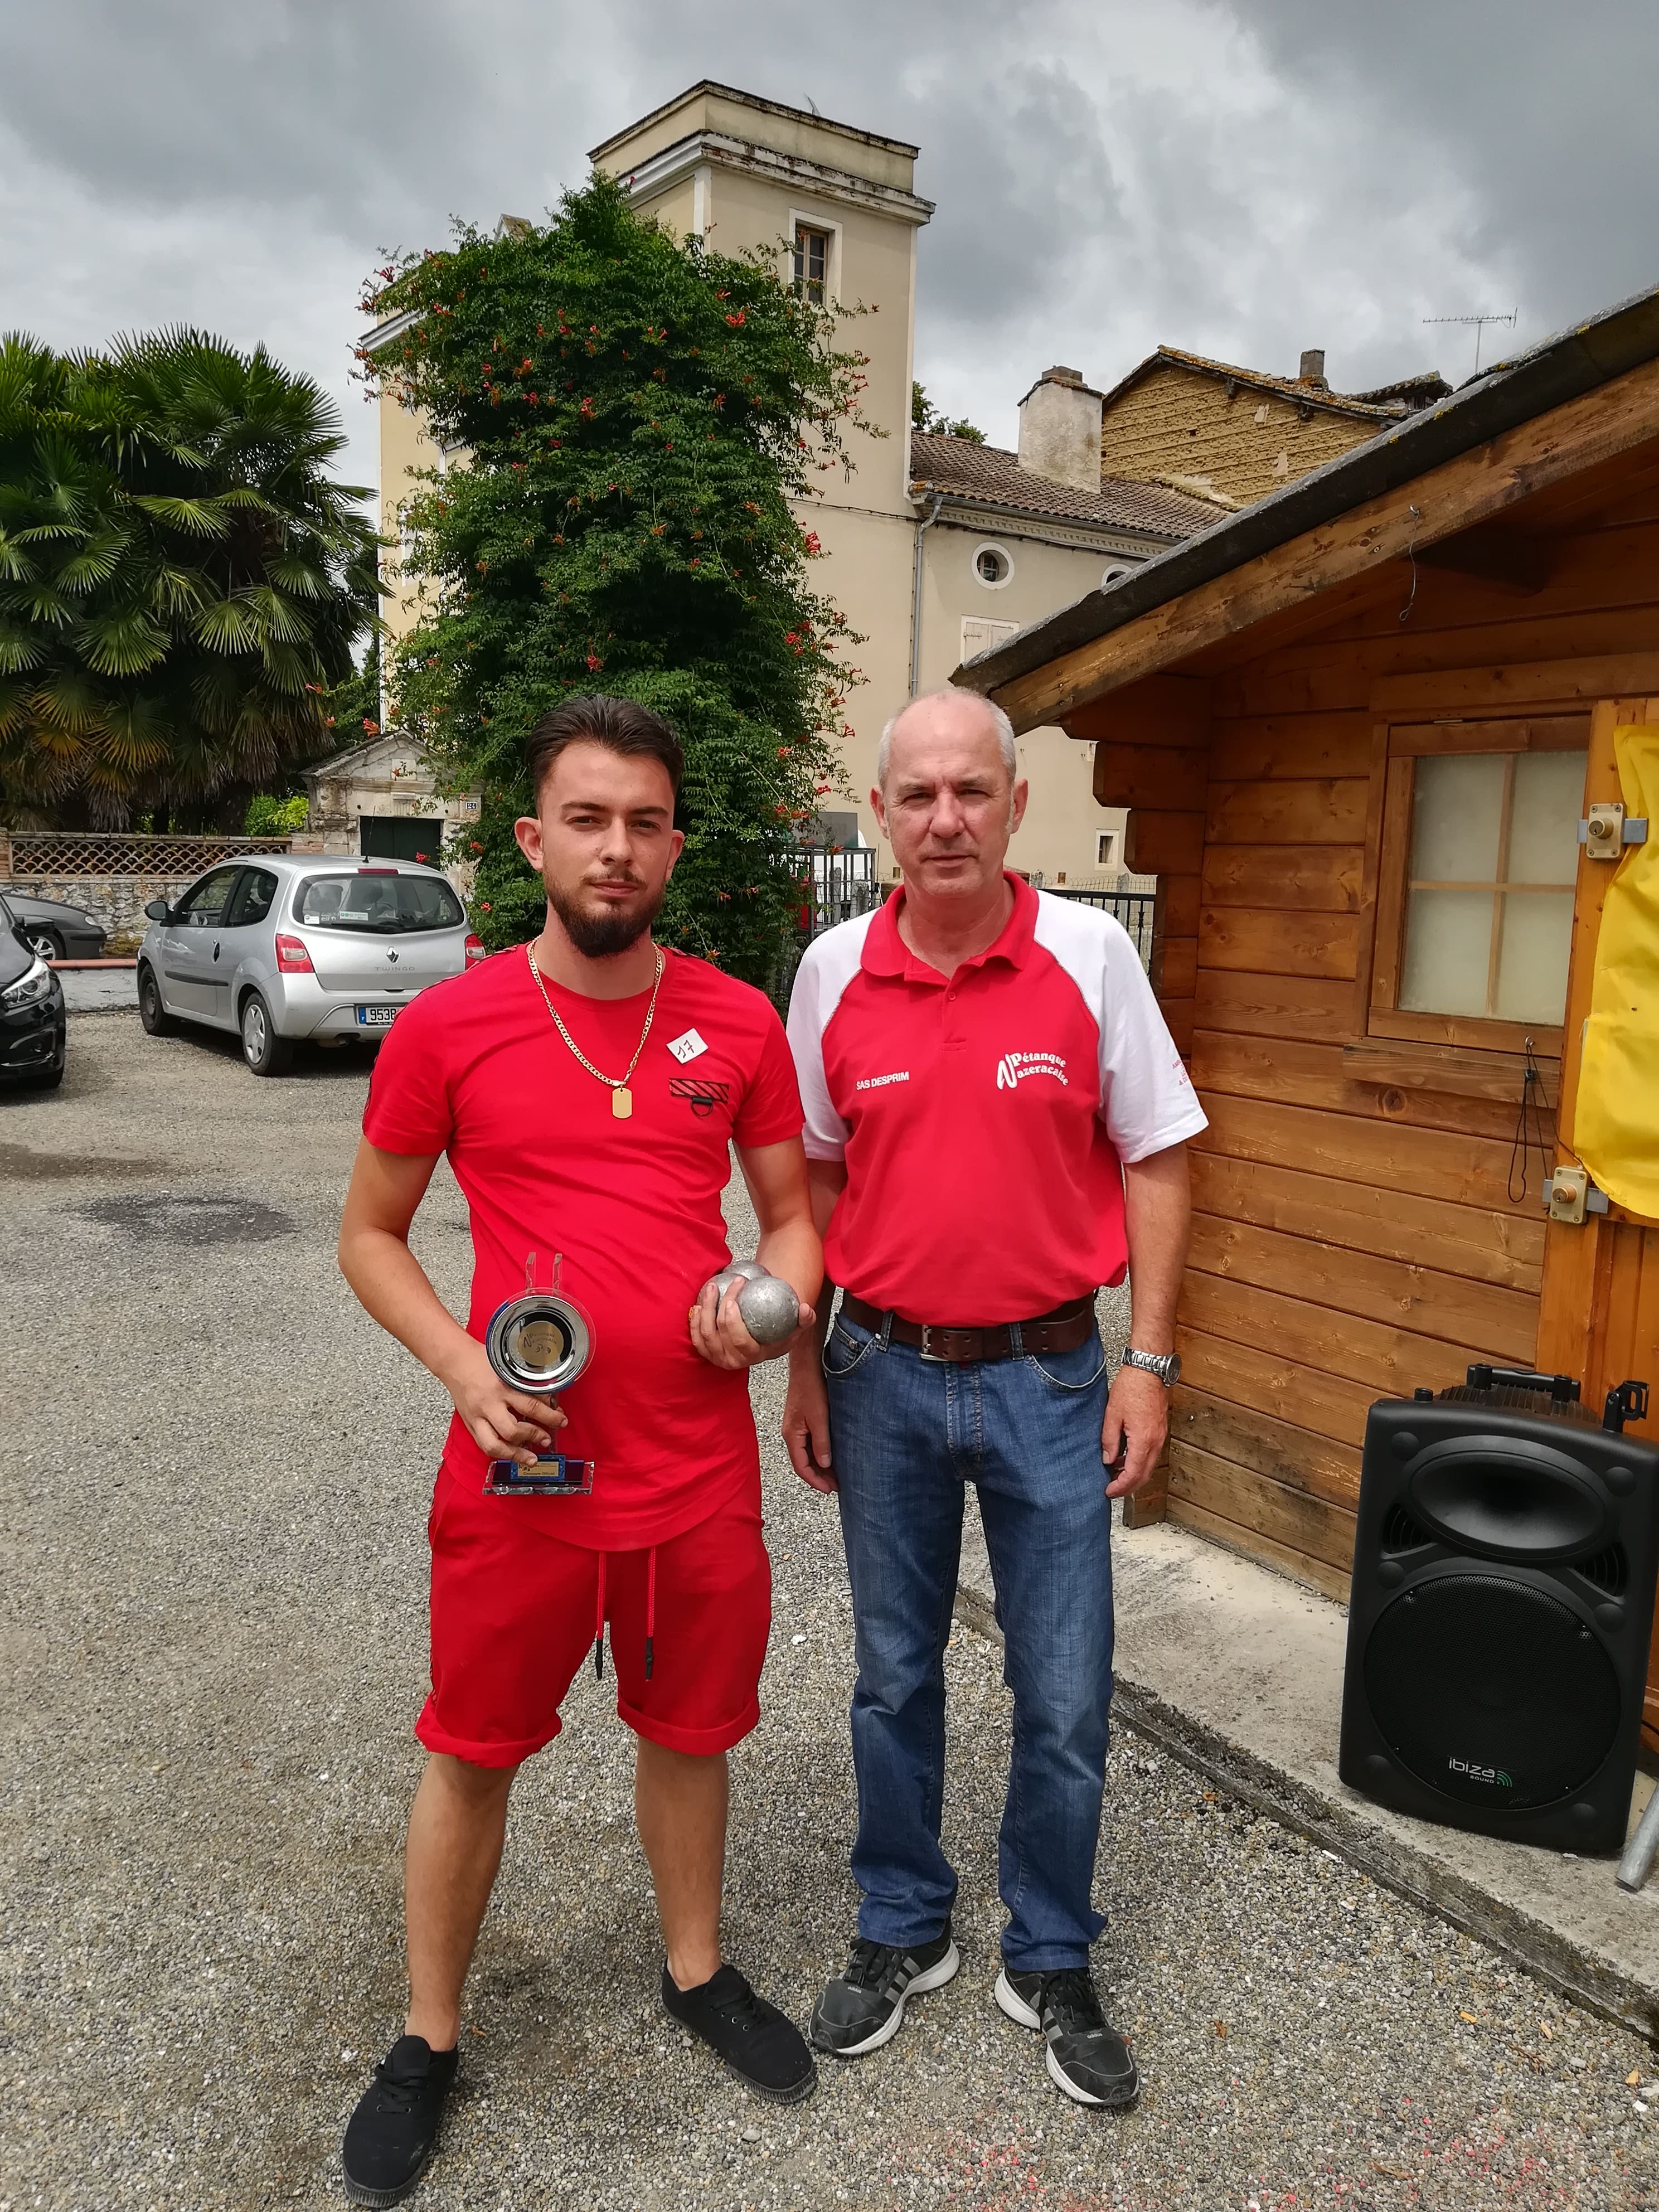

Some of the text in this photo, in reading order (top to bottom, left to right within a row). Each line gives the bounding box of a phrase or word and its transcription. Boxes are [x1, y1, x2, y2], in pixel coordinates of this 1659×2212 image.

[1009, 1052, 1066, 1068] Pétanque
[856, 1071, 910, 1090] SAS DESPRIM
[1449, 1758, 1495, 1778] ibiza
[1469, 1775, 1495, 1783] SOUND
